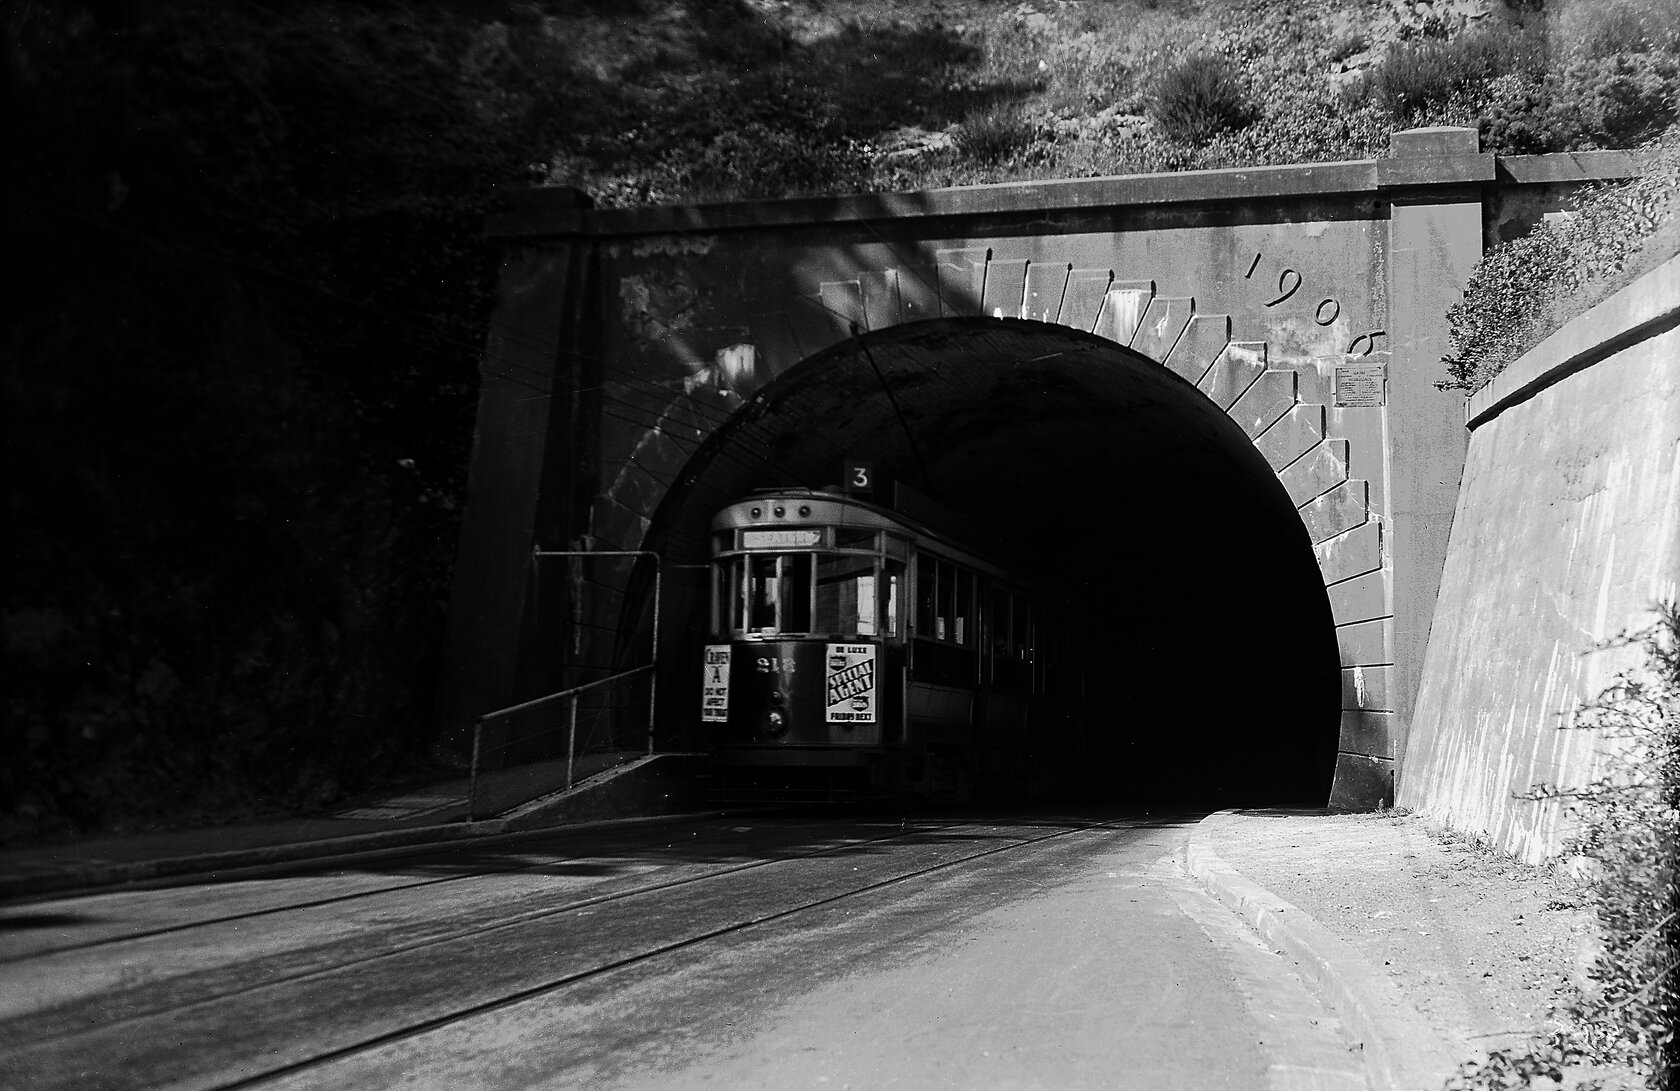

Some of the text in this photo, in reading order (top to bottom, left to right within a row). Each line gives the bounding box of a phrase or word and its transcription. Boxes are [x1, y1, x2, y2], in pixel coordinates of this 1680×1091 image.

[1245, 252, 1386, 357] 1906
[853, 467, 868, 487] 3
[848, 646, 867, 654] LUXE
[712, 665, 722, 683] A
[829, 662, 872, 688] SPECIAL
[829, 675, 872, 703] AGENT
[831, 712, 872, 720] FRIDAY NEXT
